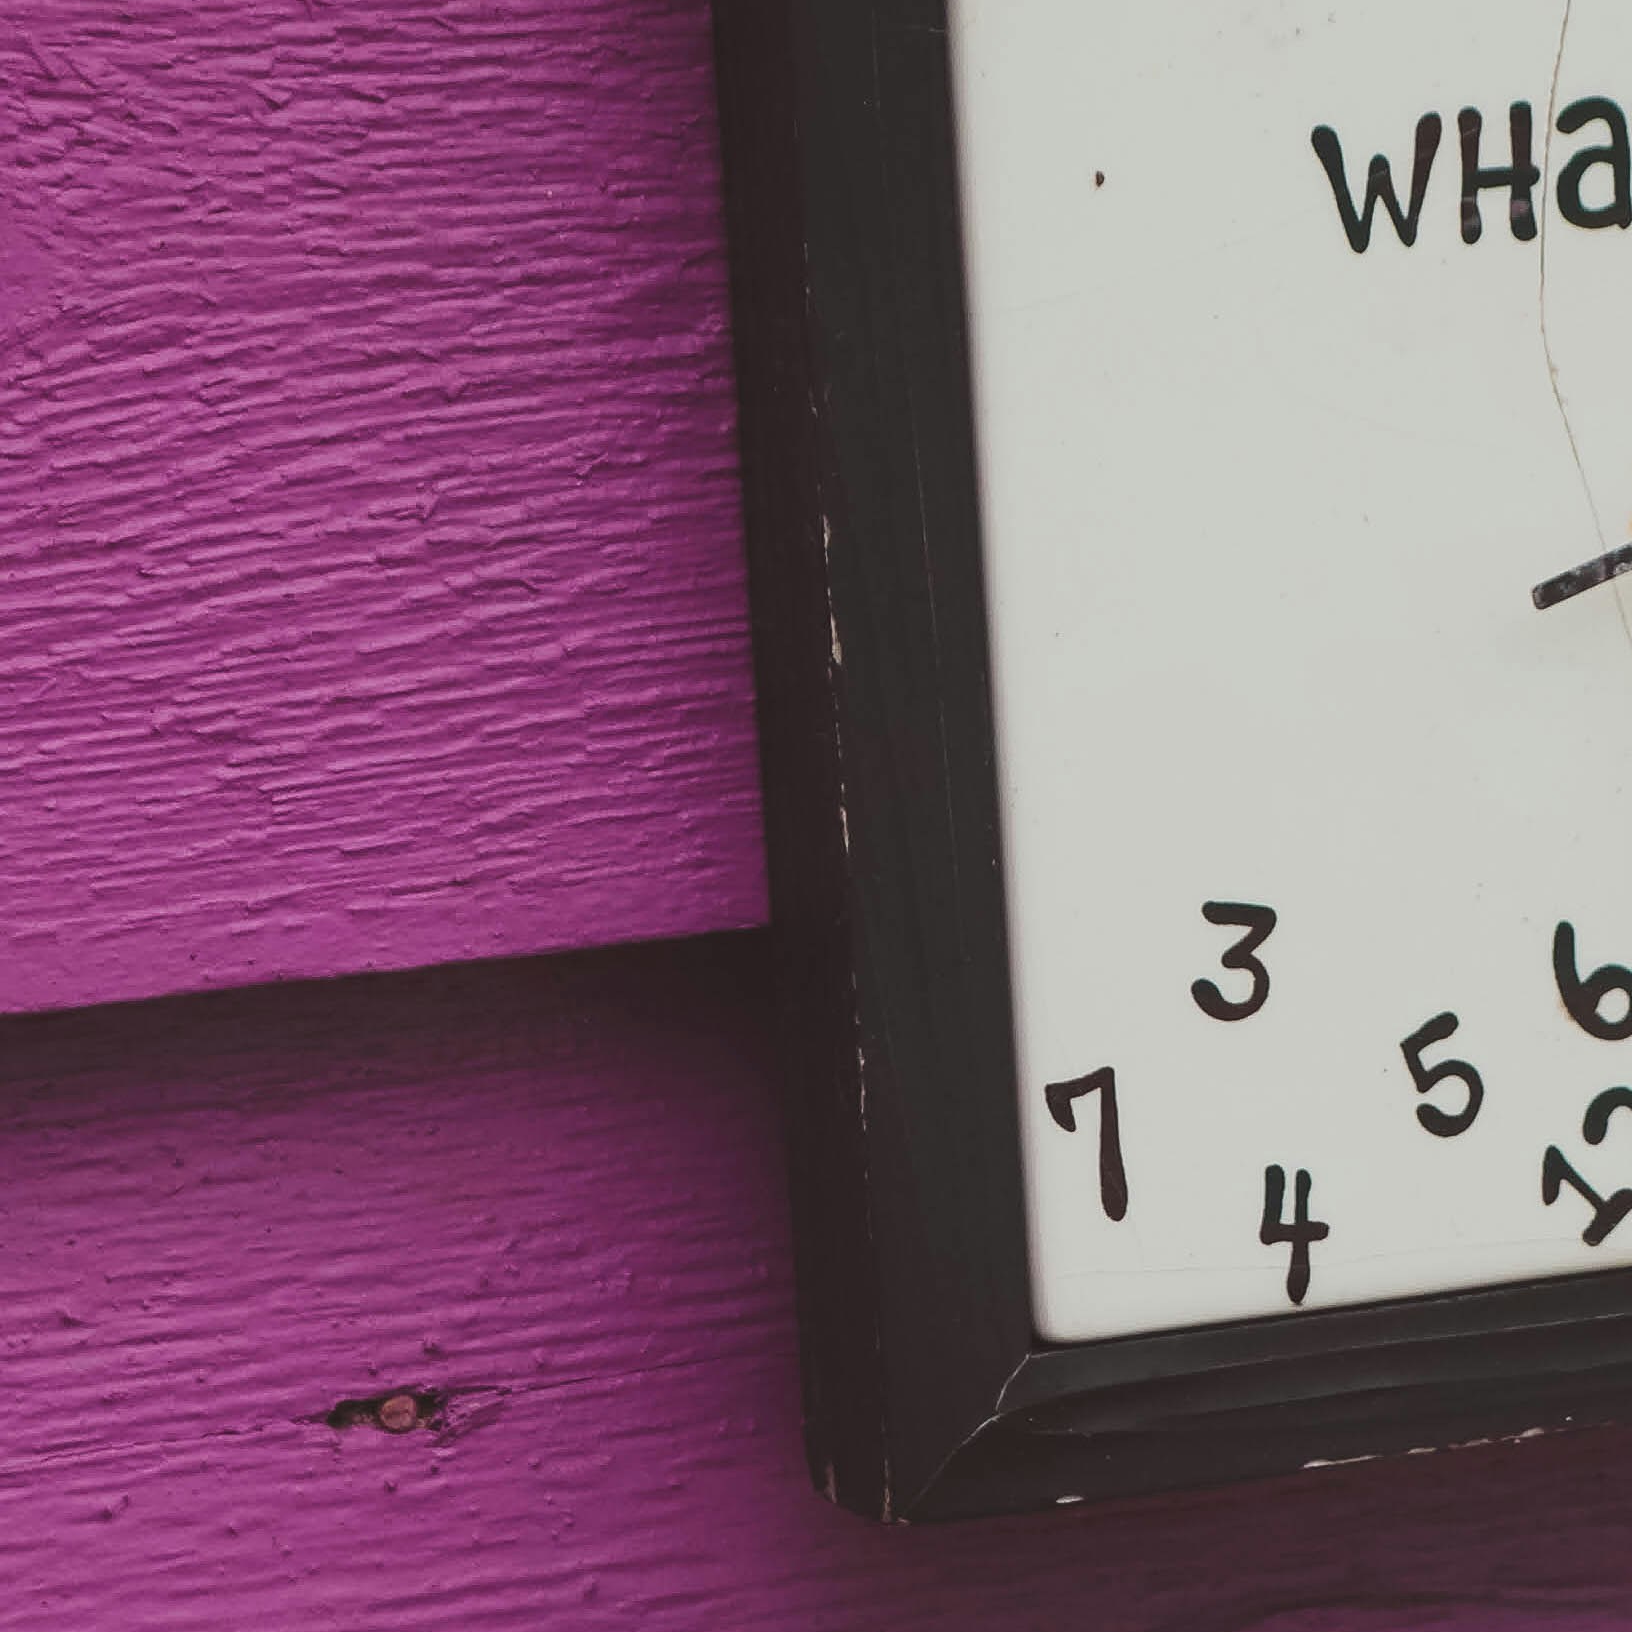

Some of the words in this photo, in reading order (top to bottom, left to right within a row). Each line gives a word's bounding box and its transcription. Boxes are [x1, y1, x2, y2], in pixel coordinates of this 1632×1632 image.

[1191, 900, 1278, 1022] 3
[1400, 1011, 1485, 1139] 5
[1044, 1066, 1130, 1223] 7
[1259, 1163, 1331, 1308] 4
